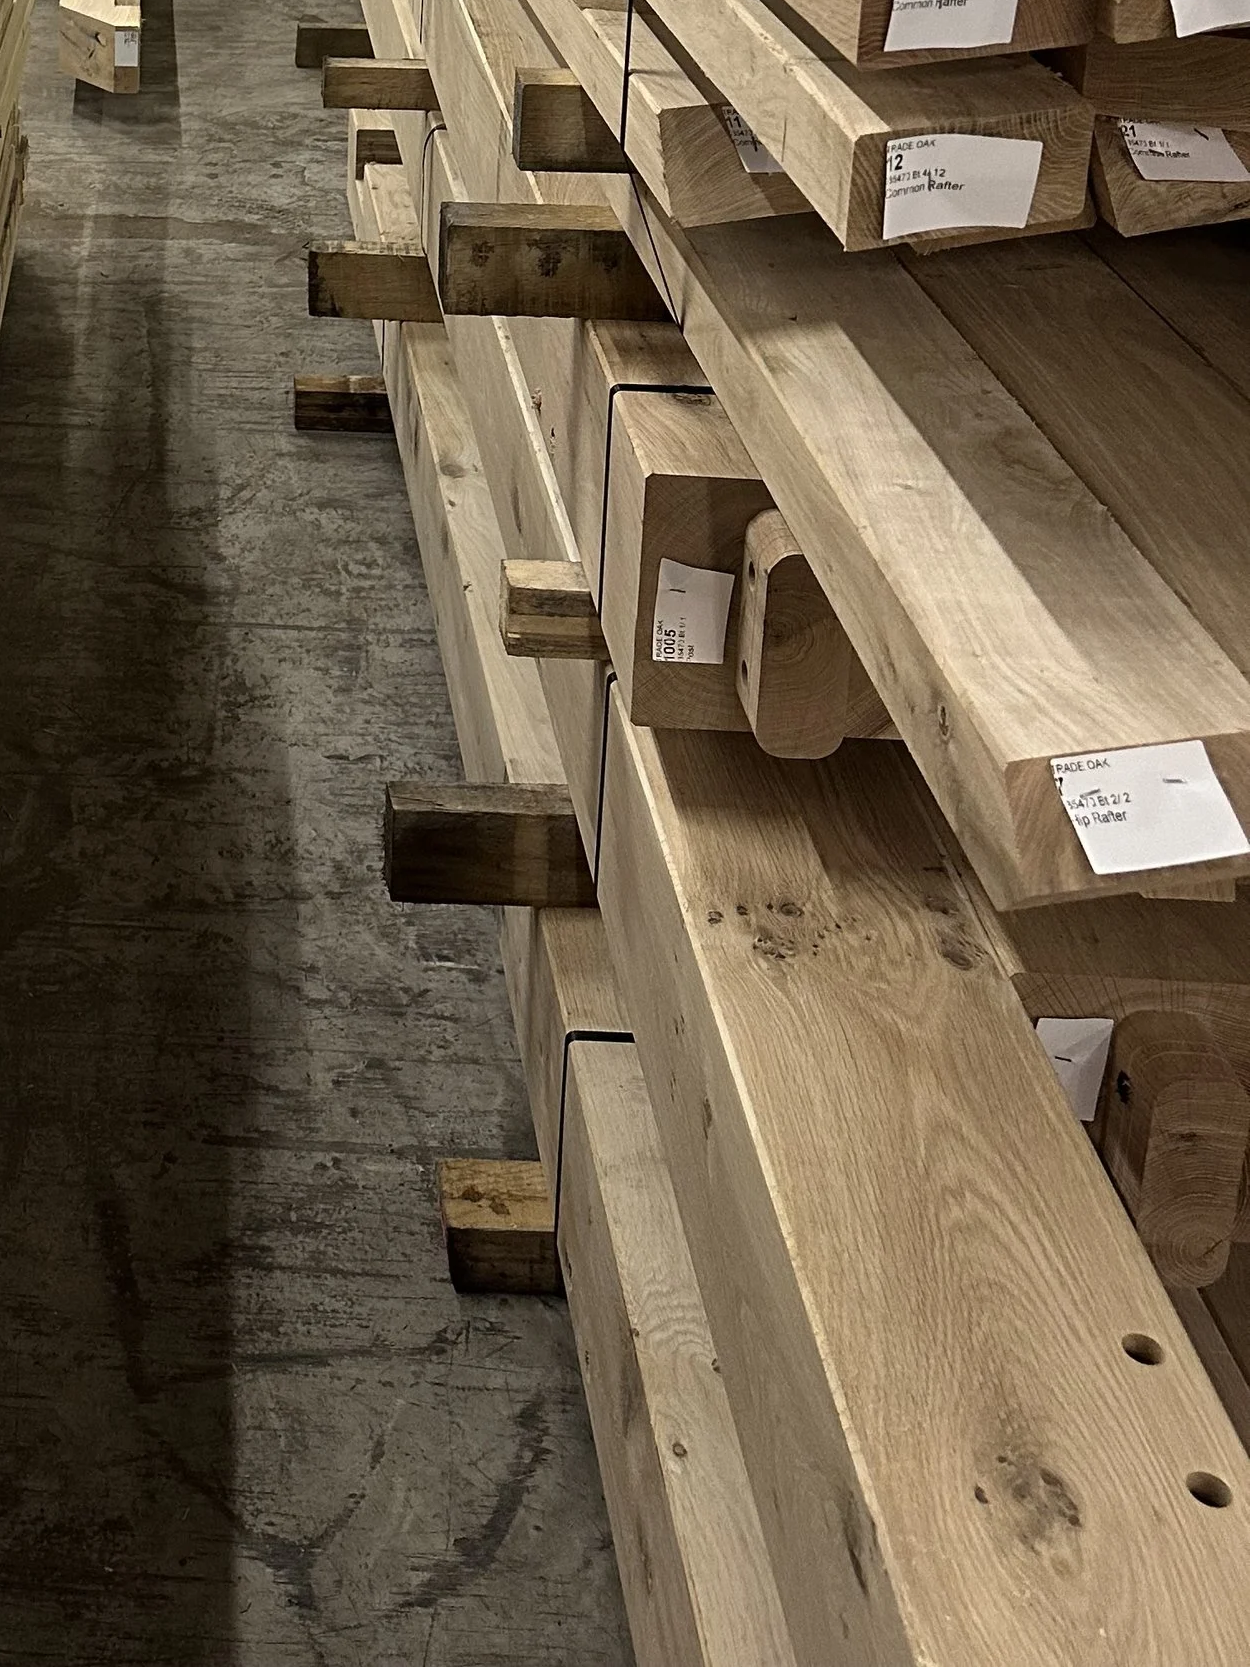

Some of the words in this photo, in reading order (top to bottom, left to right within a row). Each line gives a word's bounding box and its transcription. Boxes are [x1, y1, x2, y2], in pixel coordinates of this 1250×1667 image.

[916, 139, 936, 149] OAK
[889, 154, 903, 171] 12
[929, 180, 965, 191] Rafter
[663, 628, 677, 662] 1005
[1087, 758, 1110, 770] OAK
[1091, 809, 1127, 824] Rafter
